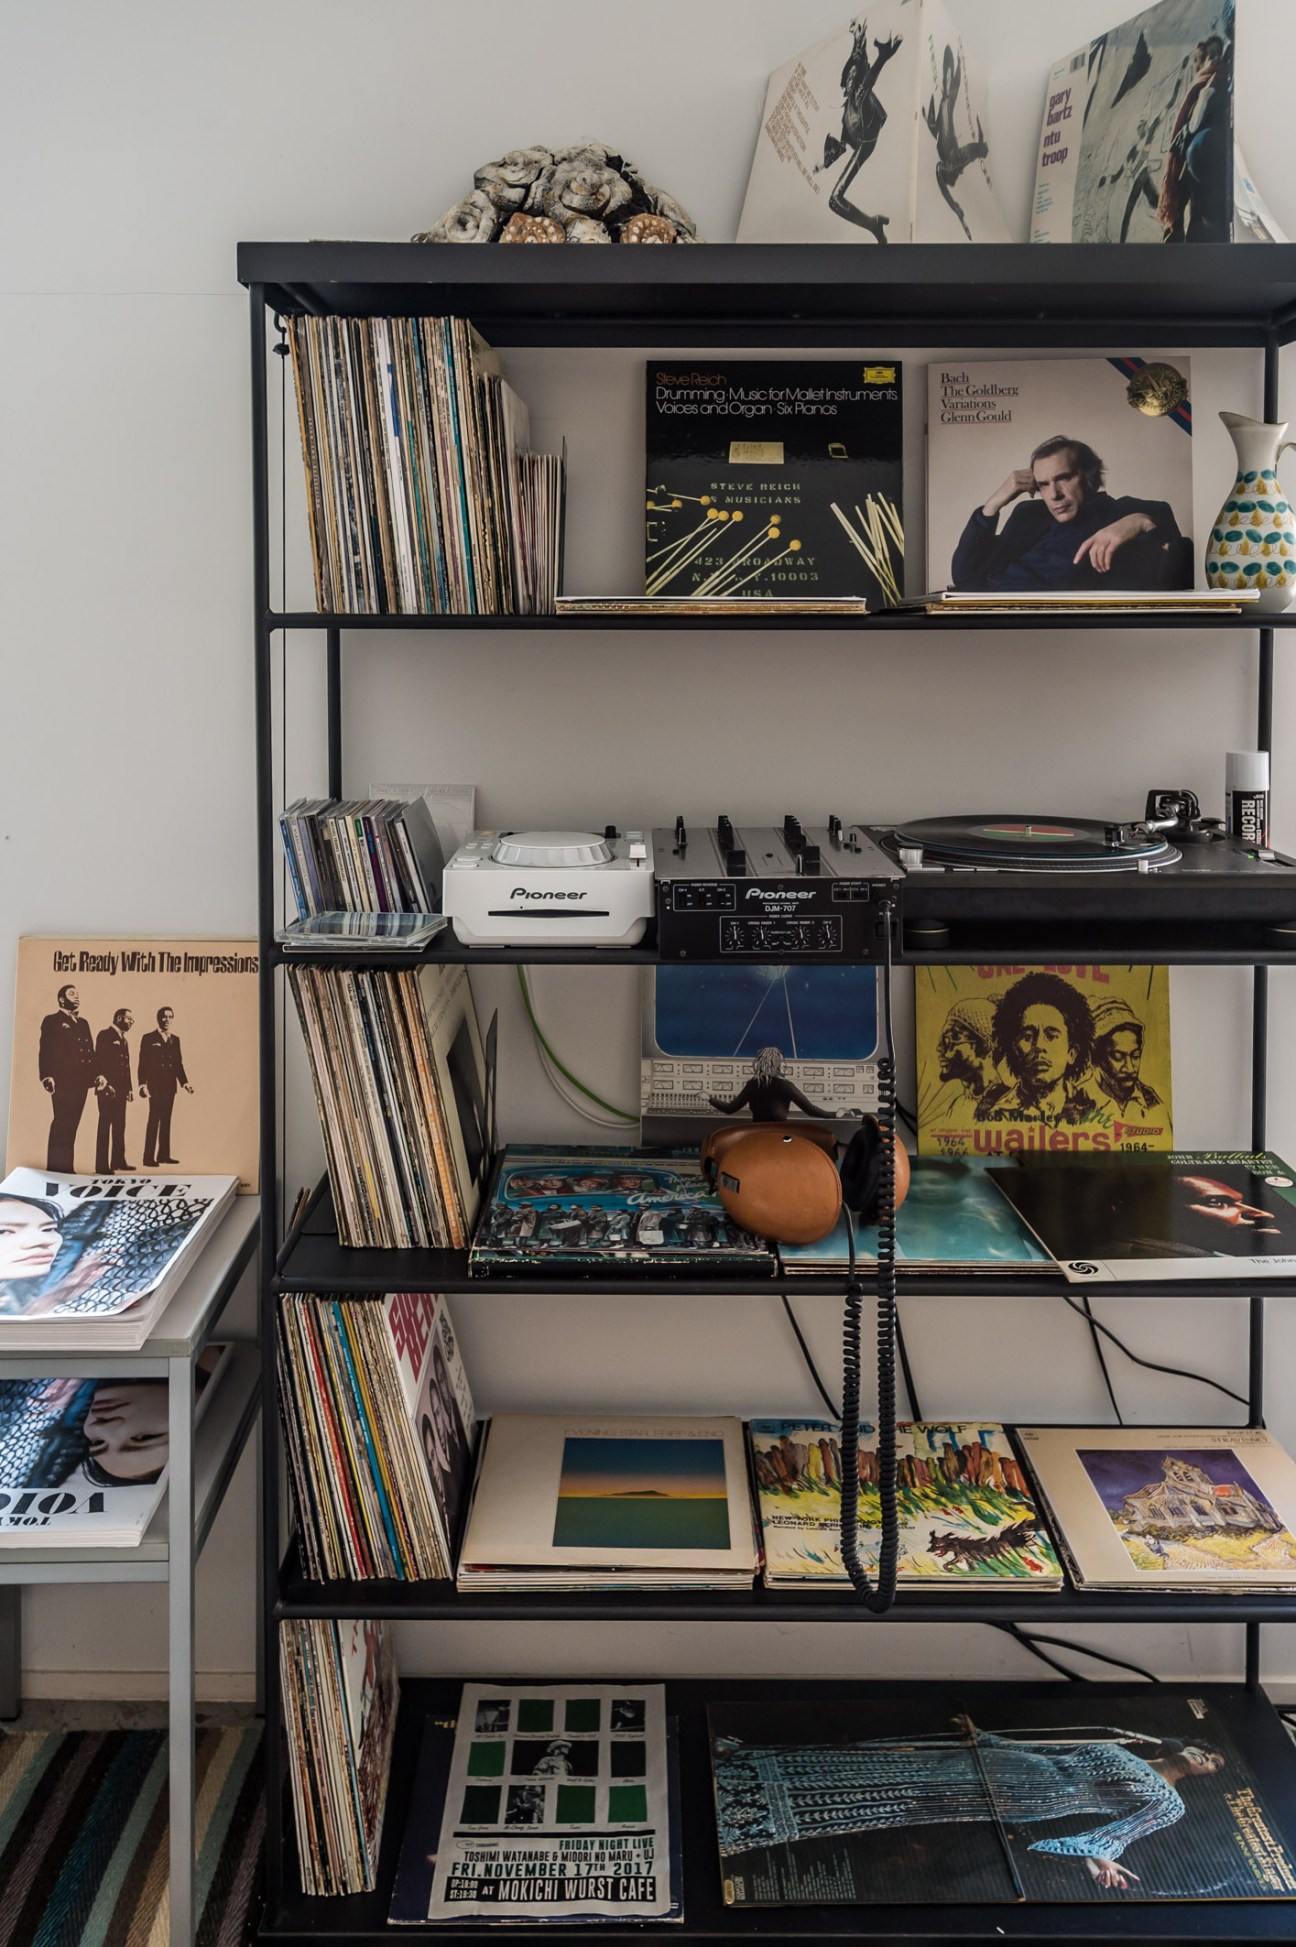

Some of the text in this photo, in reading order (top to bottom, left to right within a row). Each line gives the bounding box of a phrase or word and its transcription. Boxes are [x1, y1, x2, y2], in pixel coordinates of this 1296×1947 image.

[1050, 87, 1072, 109] gary
[1046, 105, 1073, 126] bartz
[1043, 130, 1061, 148] ntu
[1042, 147, 1068, 167] troop
[656, 372, 727, 386] Steve Reich
[941, 371, 969, 384] Bach
[656, 386, 898, 403] Drumming Music for Mallet Instruments
[941, 384, 1019, 397] The Goldberg
[656, 401, 837, 418] Voices and Organ Six Pianos
[941, 398, 997, 409] Variations
[941, 410, 1012, 422] Glenn Gould
[710, 482, 801, 491] STEVE REICH
[725, 495, 801, 504] MUSICIANS
[694, 556, 724, 566] 423
[741, 588, 774, 597] USA
[1241, 799, 1256, 844] RECOR
[510, 887, 588, 900] Pioneer
[745, 887, 817, 900] Pioneer
[53, 950, 259, 976] Get Ready With The Impressions
[974, 1124, 1112, 1152] wailers
[46, 1182, 192, 1198] VOICE
[563, 1428, 617, 1436] EVENING
[618, 1429, 649, 1437] STAR
[780, 1423, 832, 1433] PETER
[917, 1425, 968, 1434] WOLF
[772, 1519, 816, 1527] LEONARD
[559, 1837, 654, 1850] FRIDAY NIGHT LIVE
[1237, 1814, 1267, 1860] Greatest
[464, 1850, 500, 1862] TOSHIMI
[502, 1850, 550, 1862] WATANABE
[552, 1851, 559, 1862] &
[561, 1850, 592, 1862] MIDORI
[595, 1850, 606, 1862] NO
[608, 1850, 633, 1862] MARU
[574, 1862, 606, 1876] 17TH
[613, 1860, 654, 1876] 2017
[481, 1877, 654, 1900] AT MOKICHI WURST CAFE
